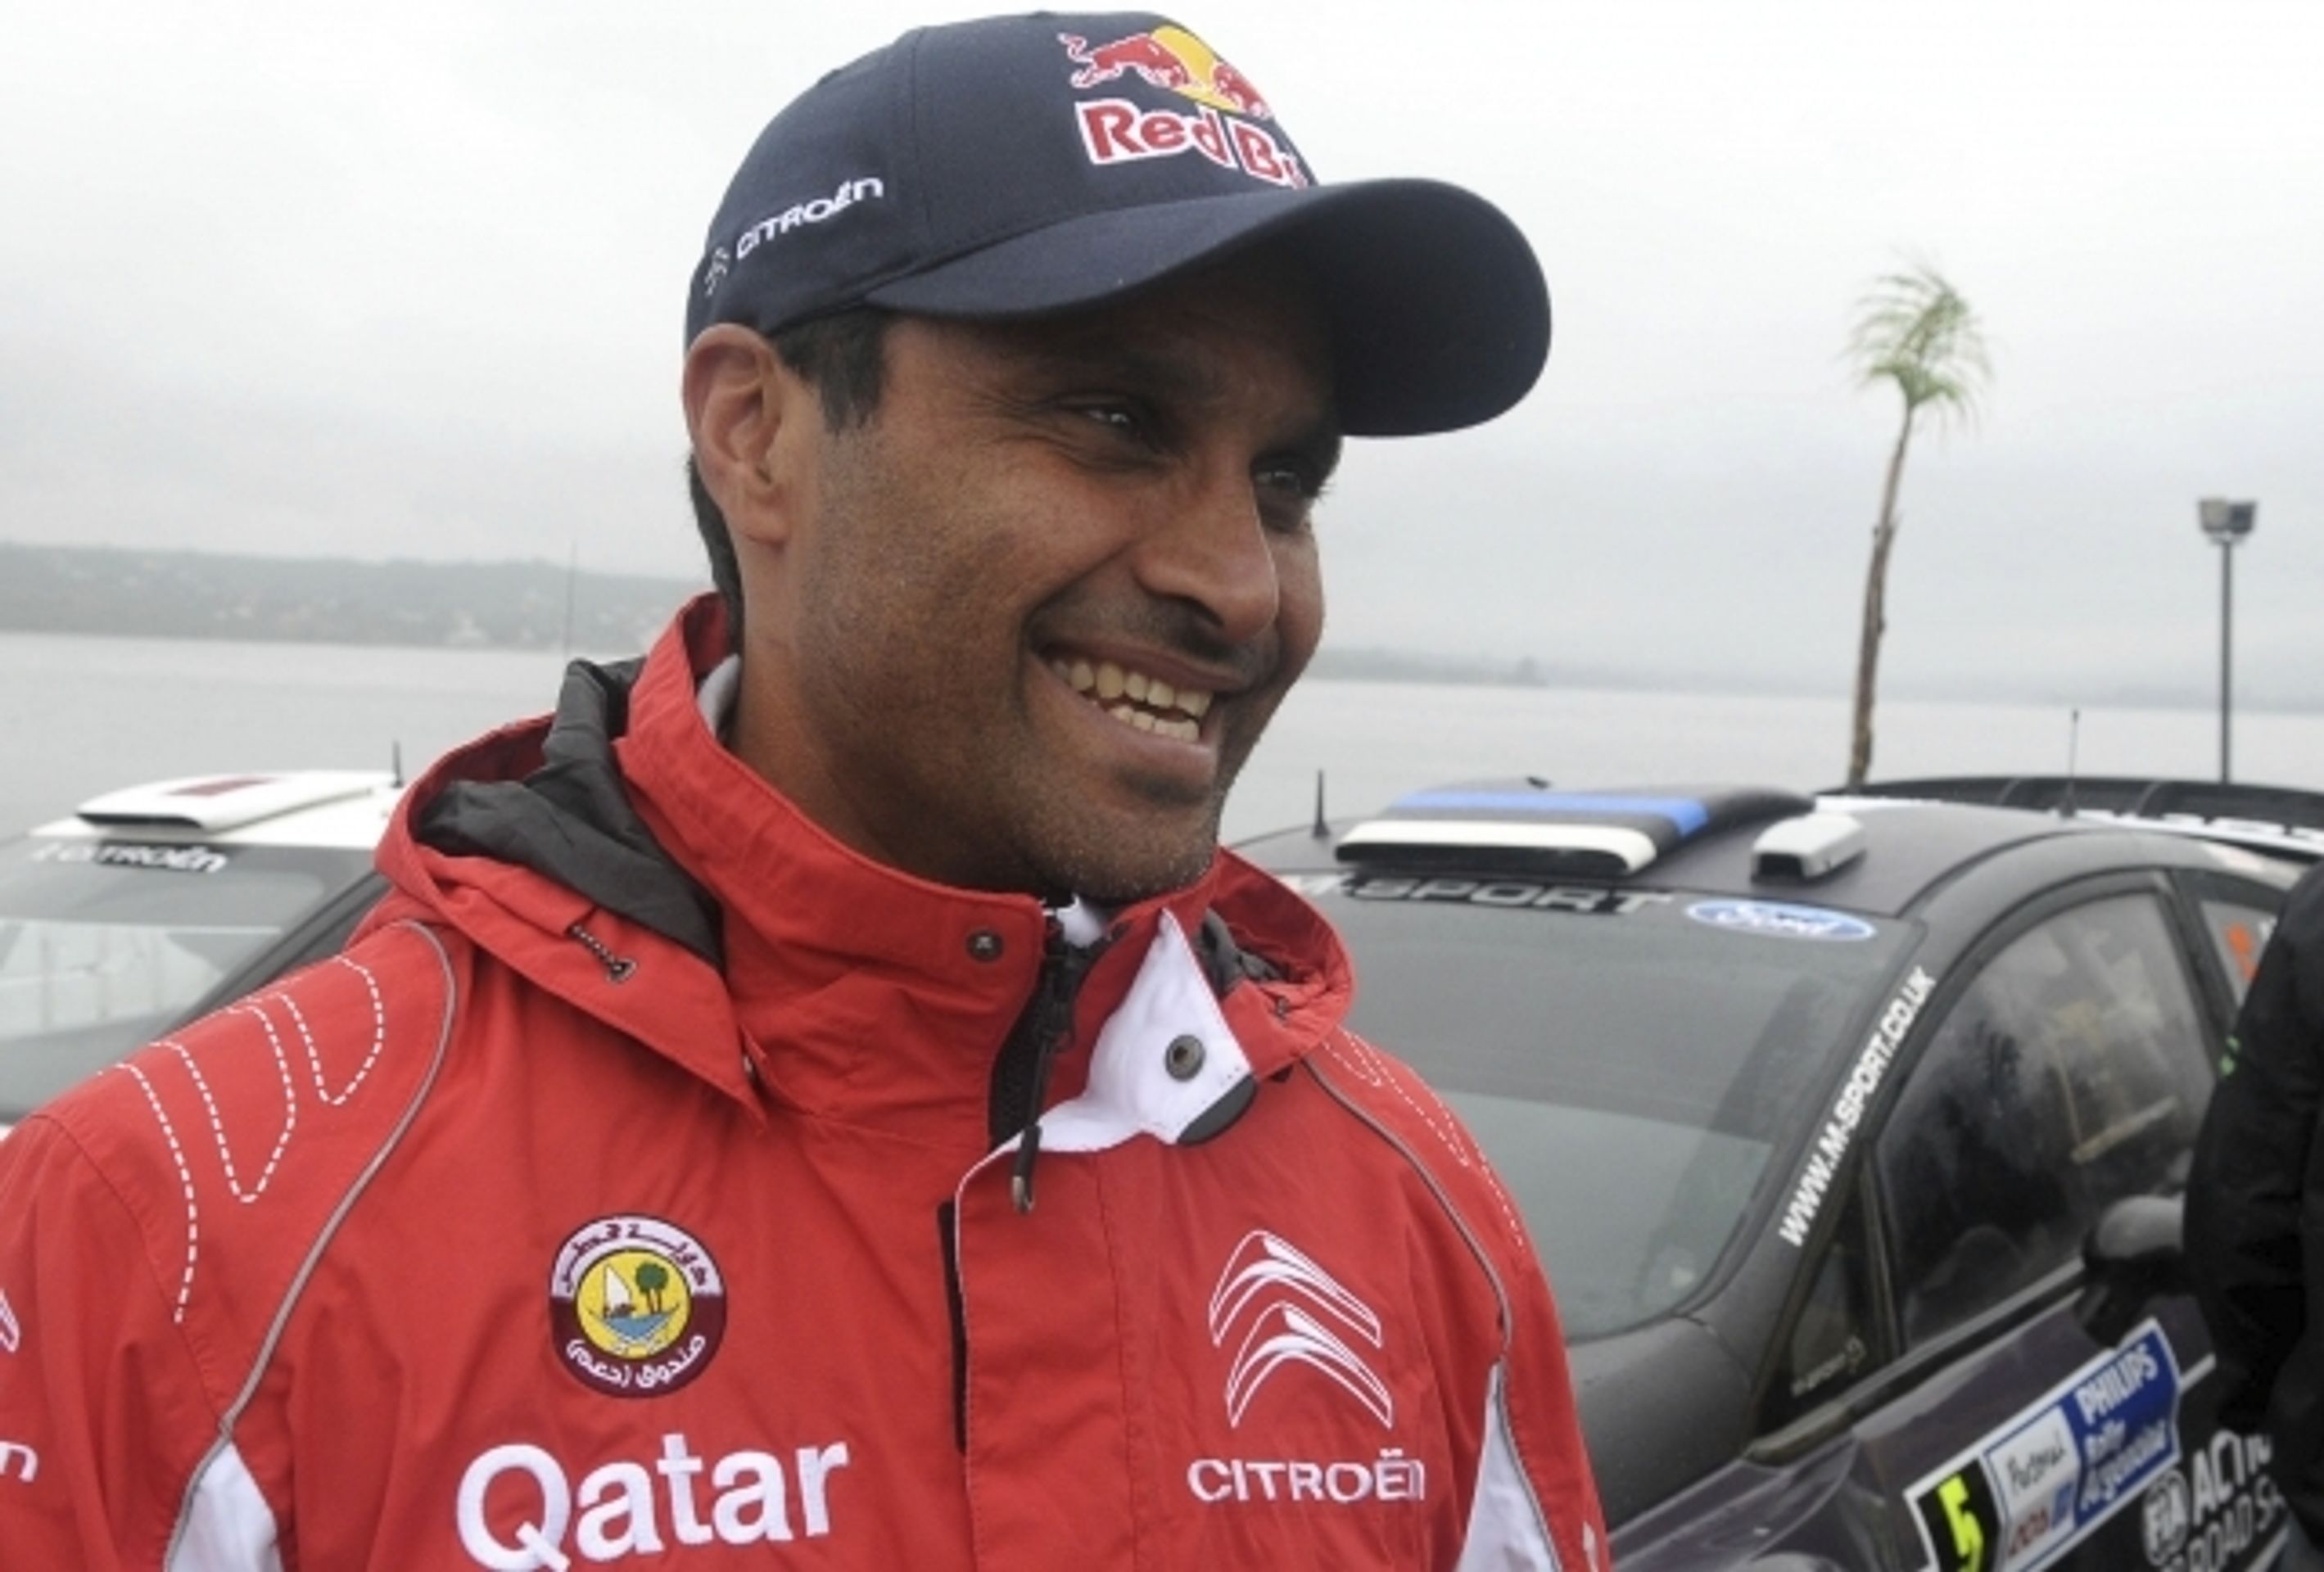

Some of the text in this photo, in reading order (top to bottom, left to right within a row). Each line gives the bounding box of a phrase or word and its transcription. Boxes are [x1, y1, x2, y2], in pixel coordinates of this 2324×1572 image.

[1076, 99, 1237, 169] Red
[1779, 965, 1937, 1247] WWW.M-SPORT.CO.UK
[2075, 1343, 2159, 1425] PHILIPS
[456, 1432, 849, 1571] Qatar
[1938, 1474, 1983, 1572] 5
